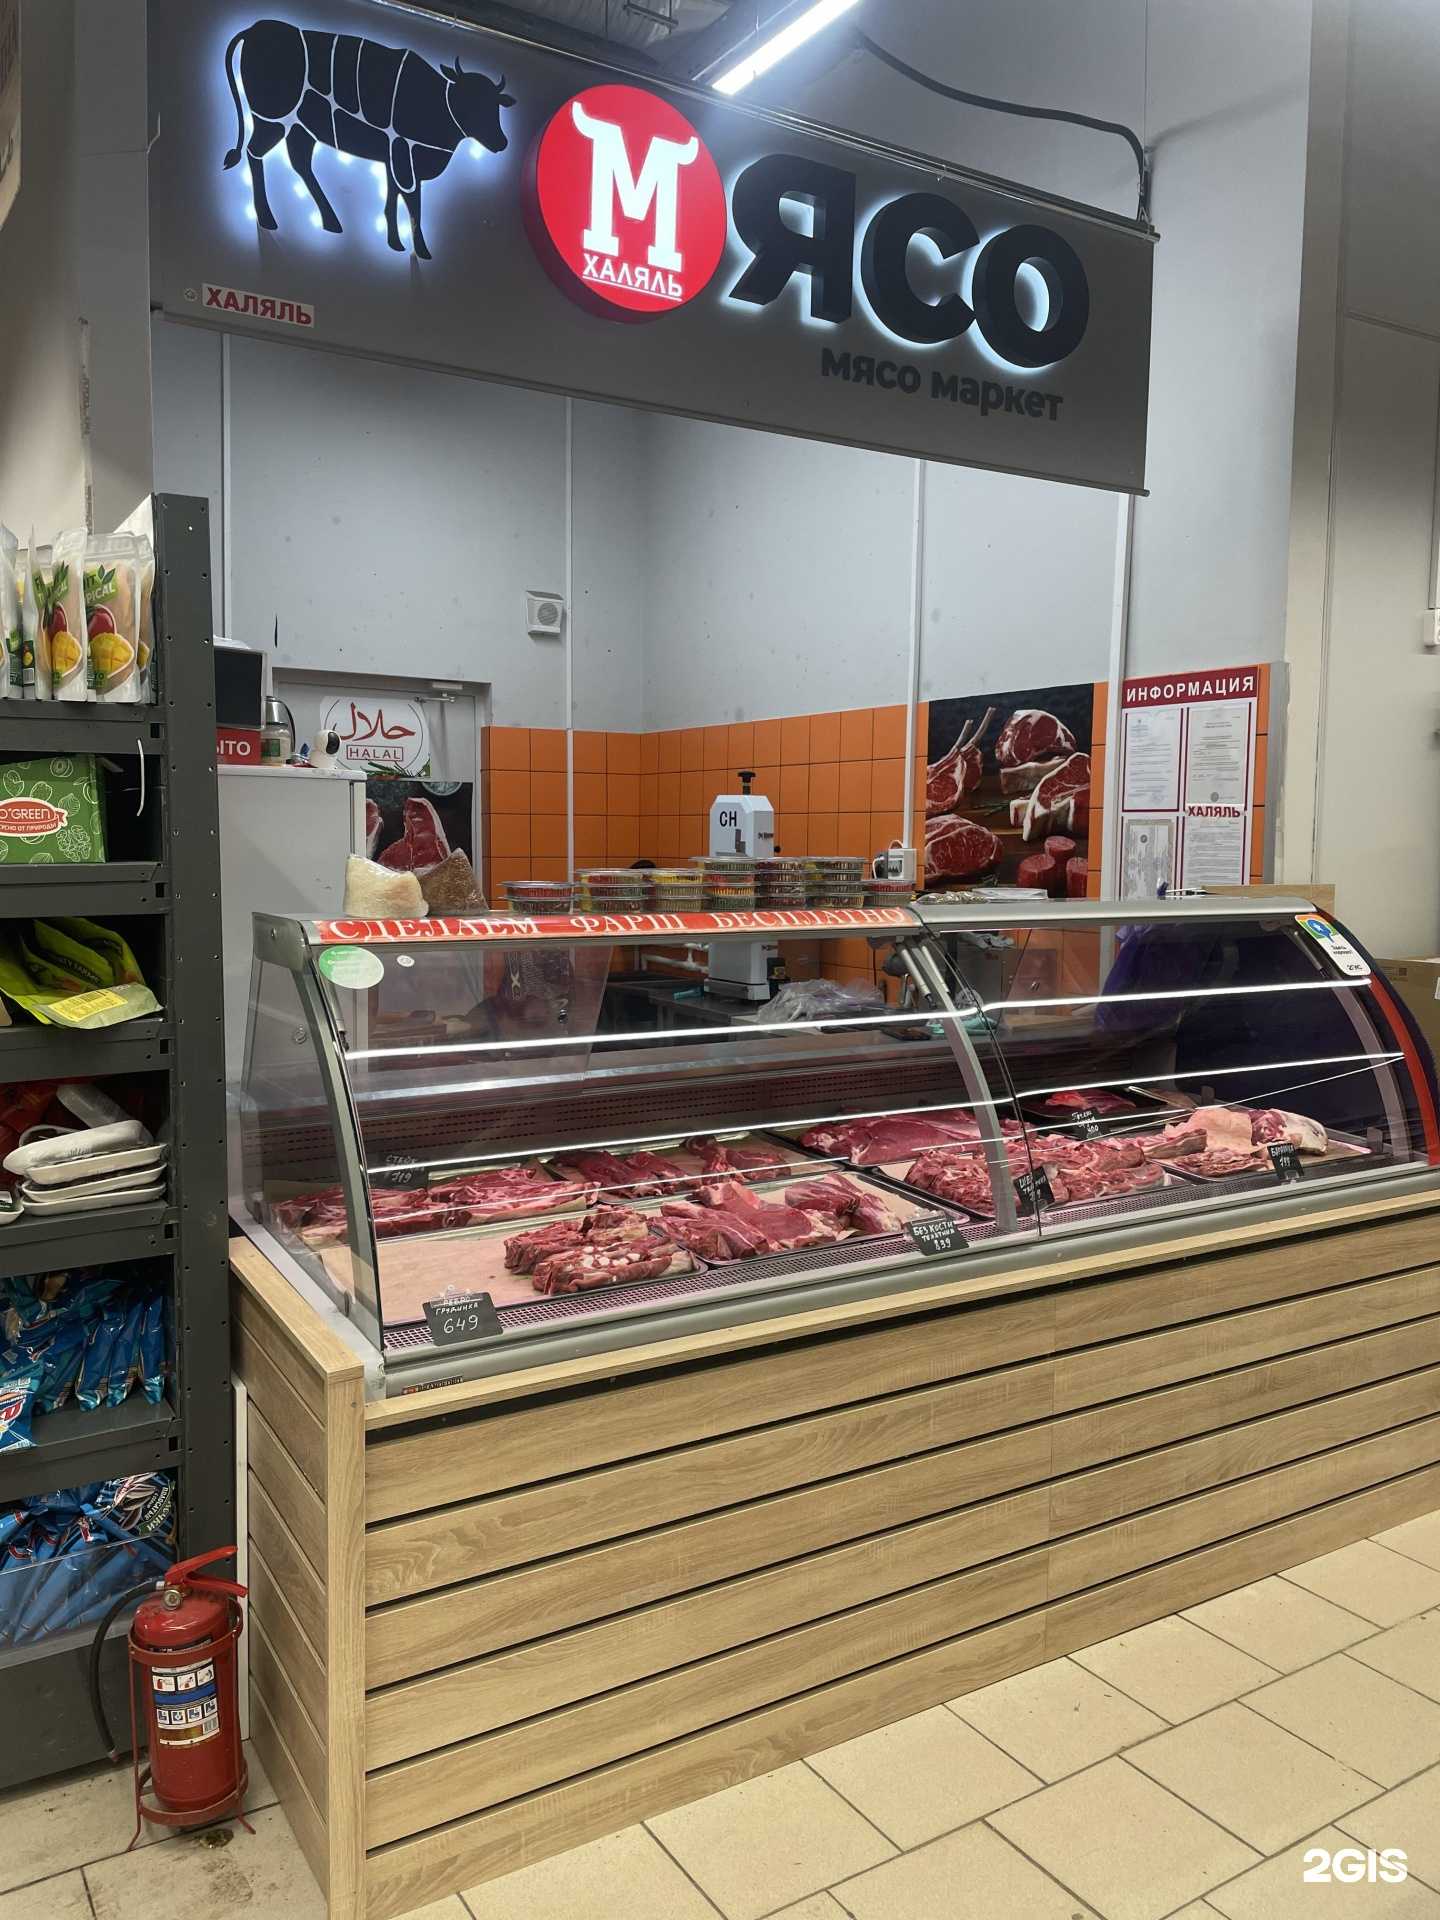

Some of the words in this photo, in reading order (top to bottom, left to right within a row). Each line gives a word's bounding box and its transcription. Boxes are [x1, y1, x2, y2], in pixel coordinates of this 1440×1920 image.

[583, 252, 683, 297] ХАЛЯЛЬ
[206, 287, 312, 325] ХАЛЯЛЬ
[821, 347, 921, 394] мясо
[931, 369, 1064, 421] маркет
[1126, 675, 1254, 702] ИНФОРМАЦИЯ
[349, 747, 400, 759] HALAL
[1187, 805, 1241, 818] ХАЛЯЛЬ
[329, 917, 542, 942] СДЕЛАЕМ
[570, 914, 688, 933] ФАРШ
[713, 907, 906, 929] БЕСПЛАТНО
[443, 1314, 478, 1334] 649
